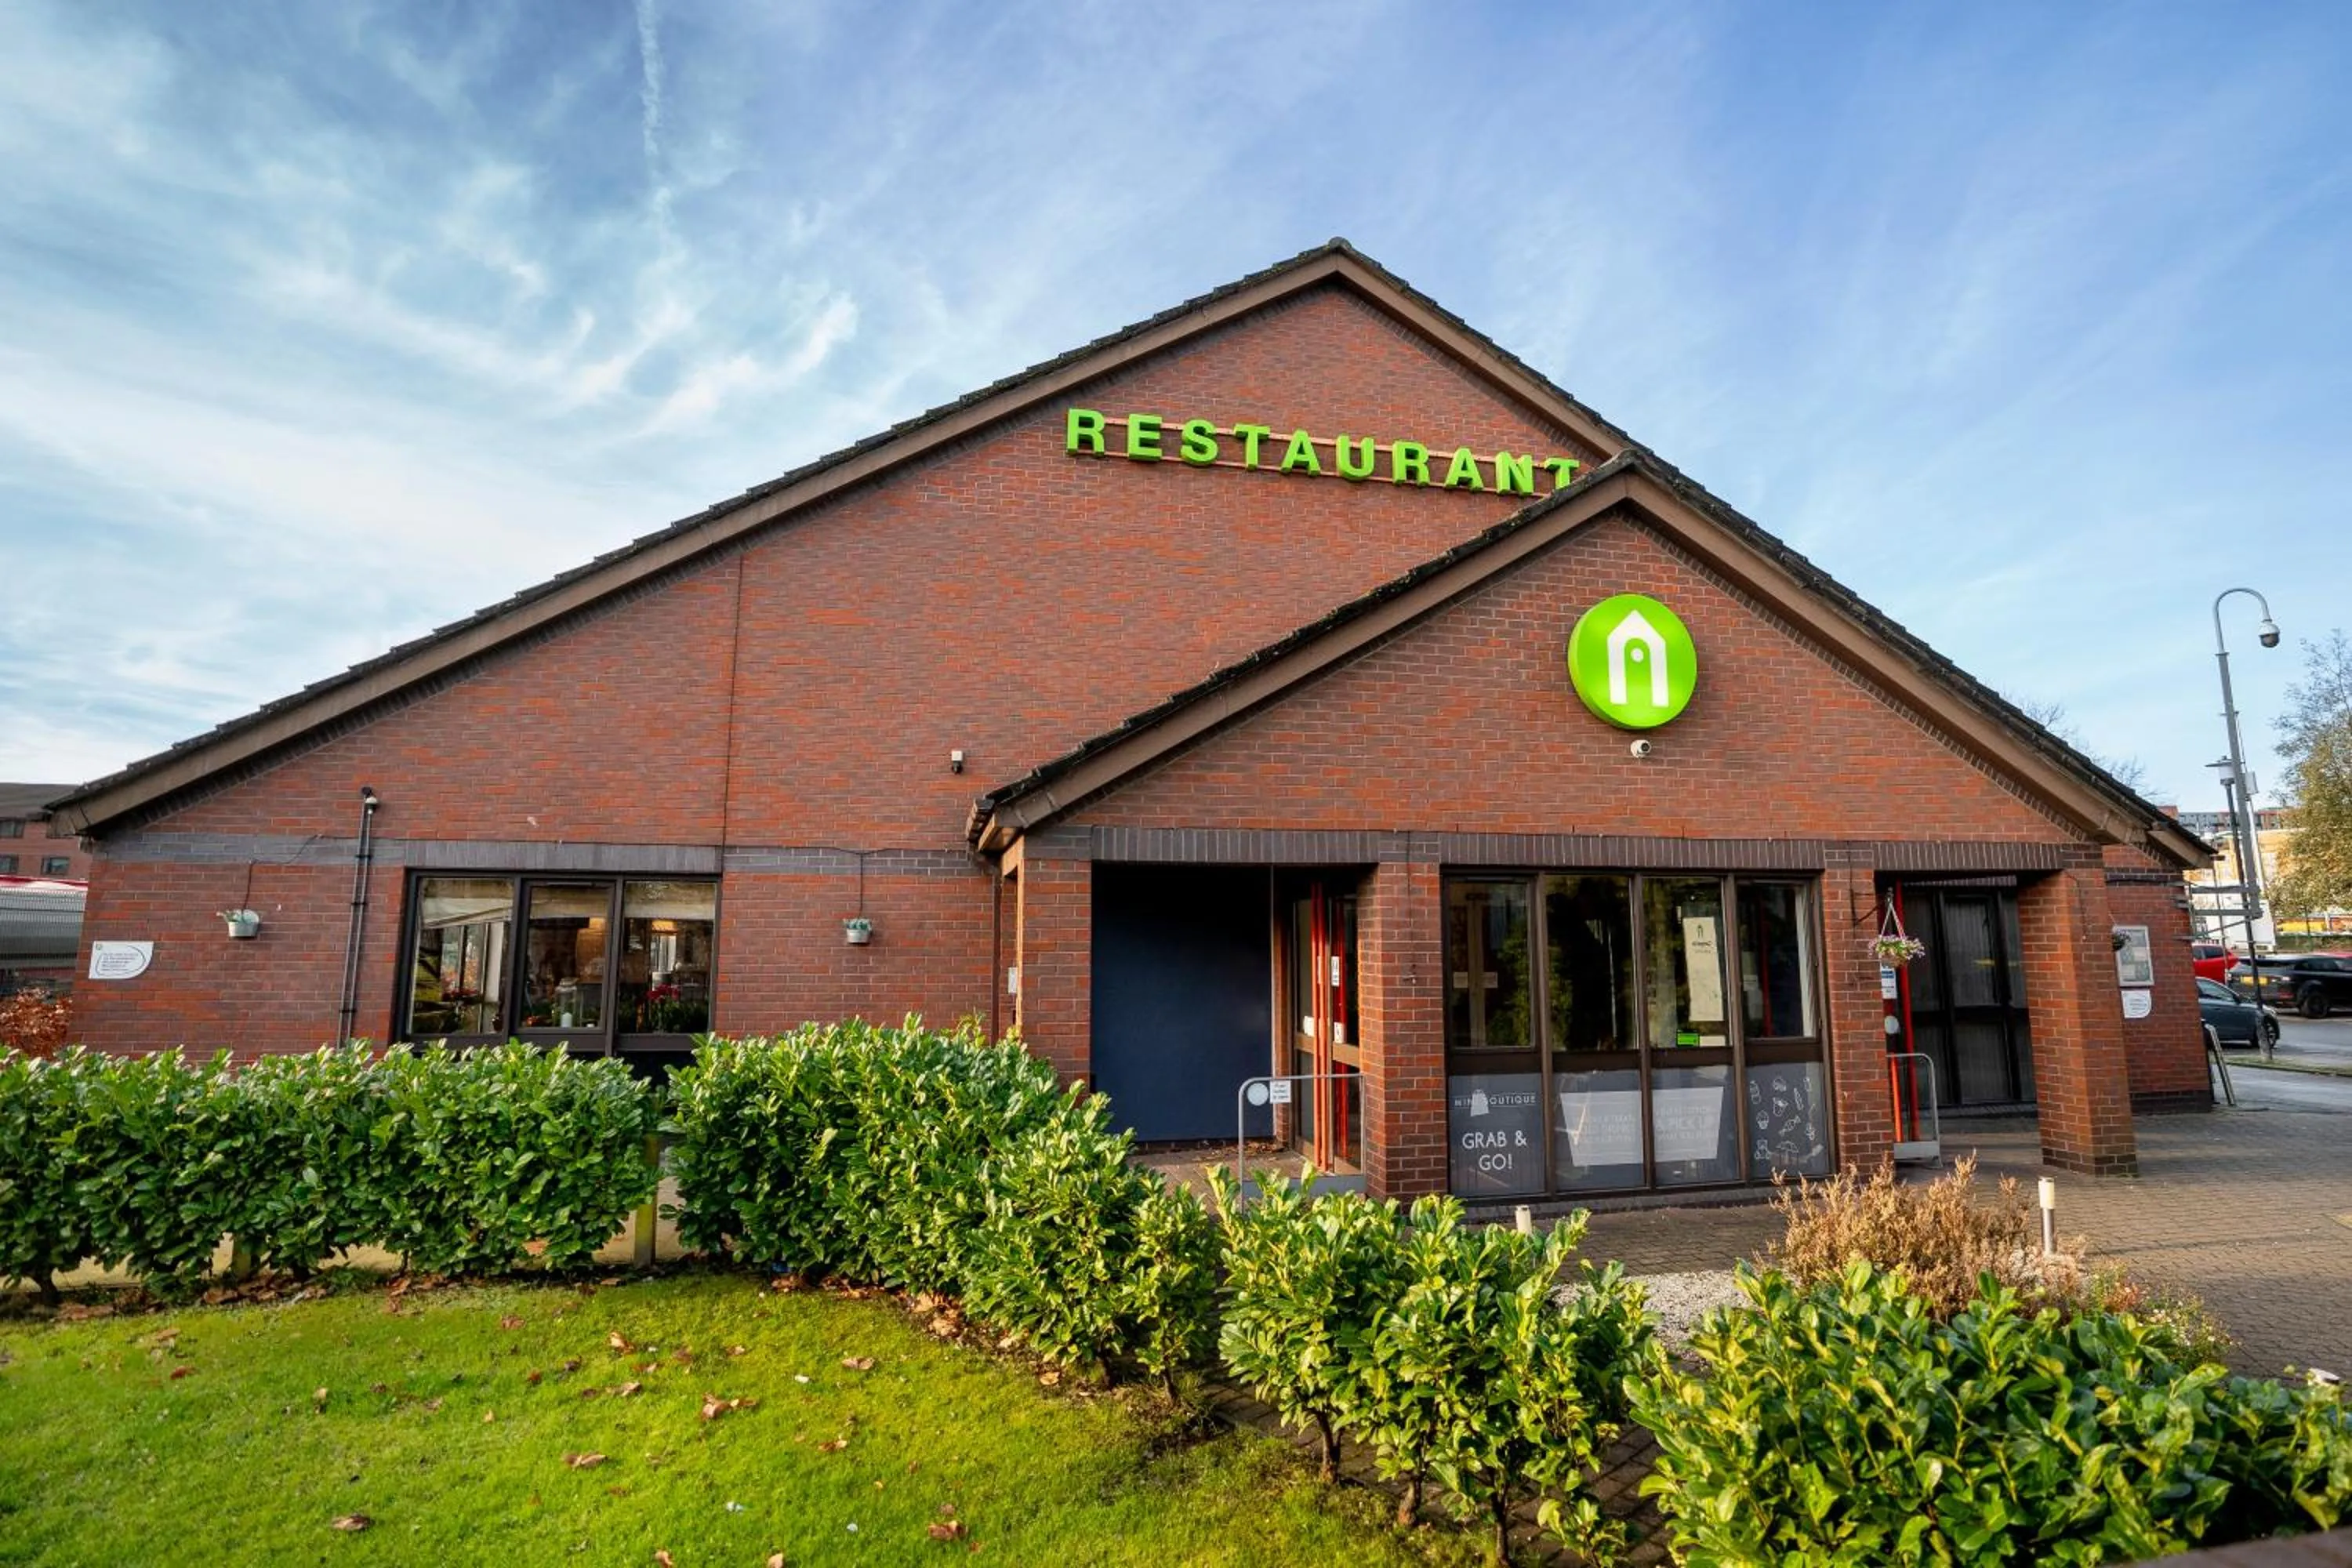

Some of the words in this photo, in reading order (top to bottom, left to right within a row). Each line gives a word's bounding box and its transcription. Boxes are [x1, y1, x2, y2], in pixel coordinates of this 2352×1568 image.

[1066, 408, 1580, 495] RESTAURANT
[1462, 1131, 1507, 1149] GRAB
[1515, 1130, 1527, 1146] &
[1479, 1153, 1512, 1171] GO!
